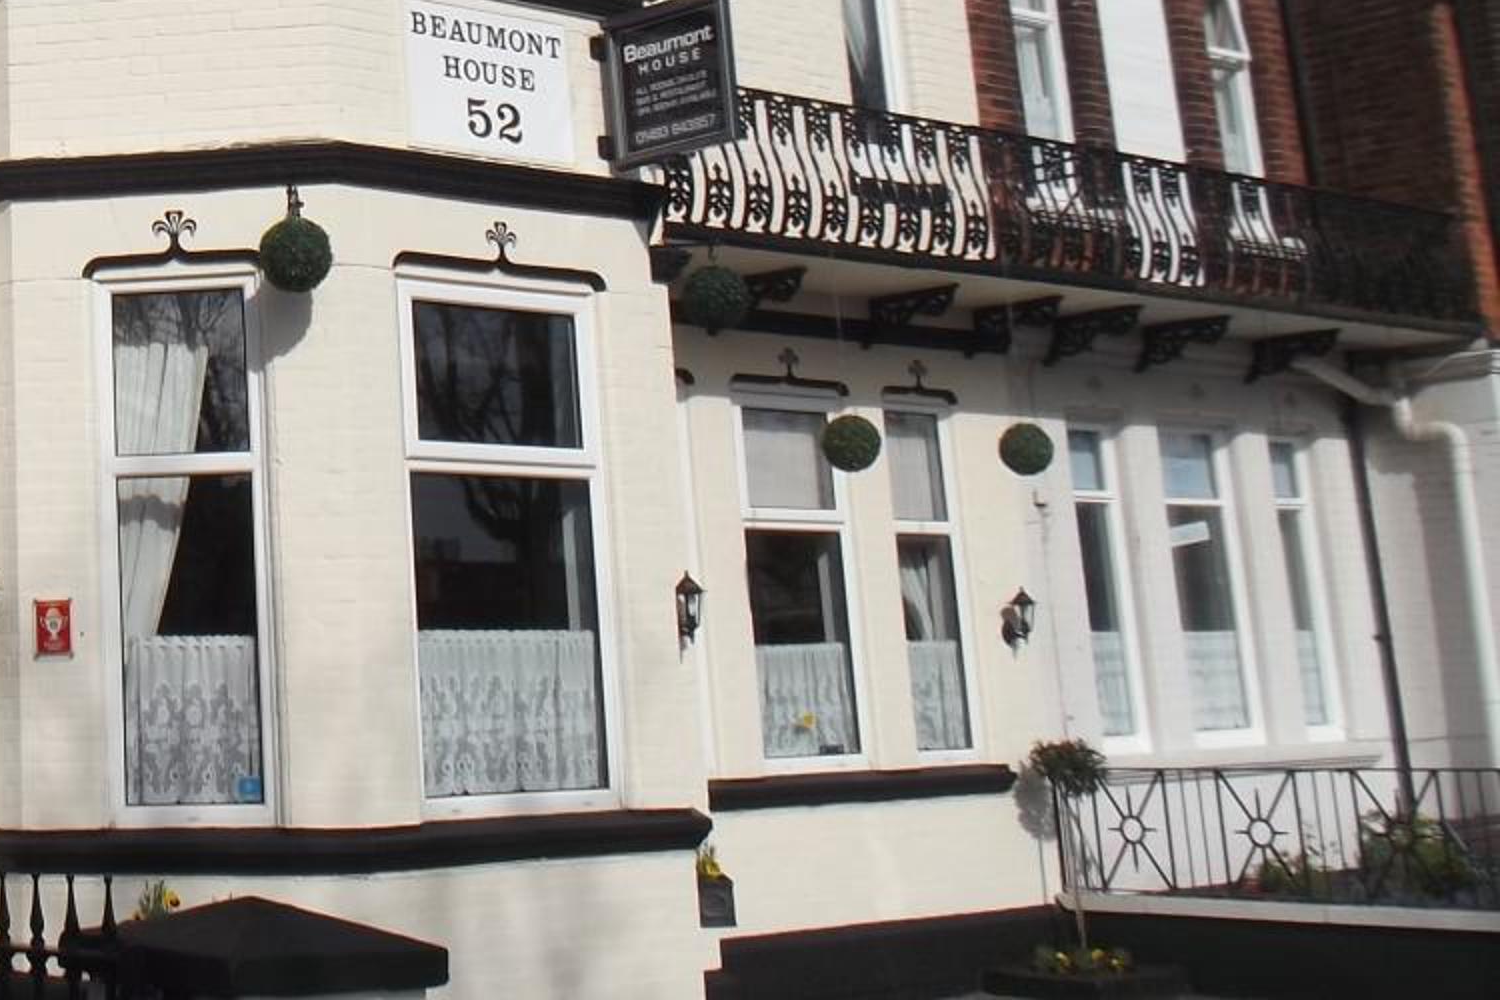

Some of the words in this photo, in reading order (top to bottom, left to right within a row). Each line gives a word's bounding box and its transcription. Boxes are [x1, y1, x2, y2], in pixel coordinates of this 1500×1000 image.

[411, 11, 561, 59] BEAUMONT
[623, 25, 714, 64] Beaumont
[443, 55, 535, 92] HOUSE
[637, 47, 702, 76] HOUSE
[467, 97, 523, 144] 52
